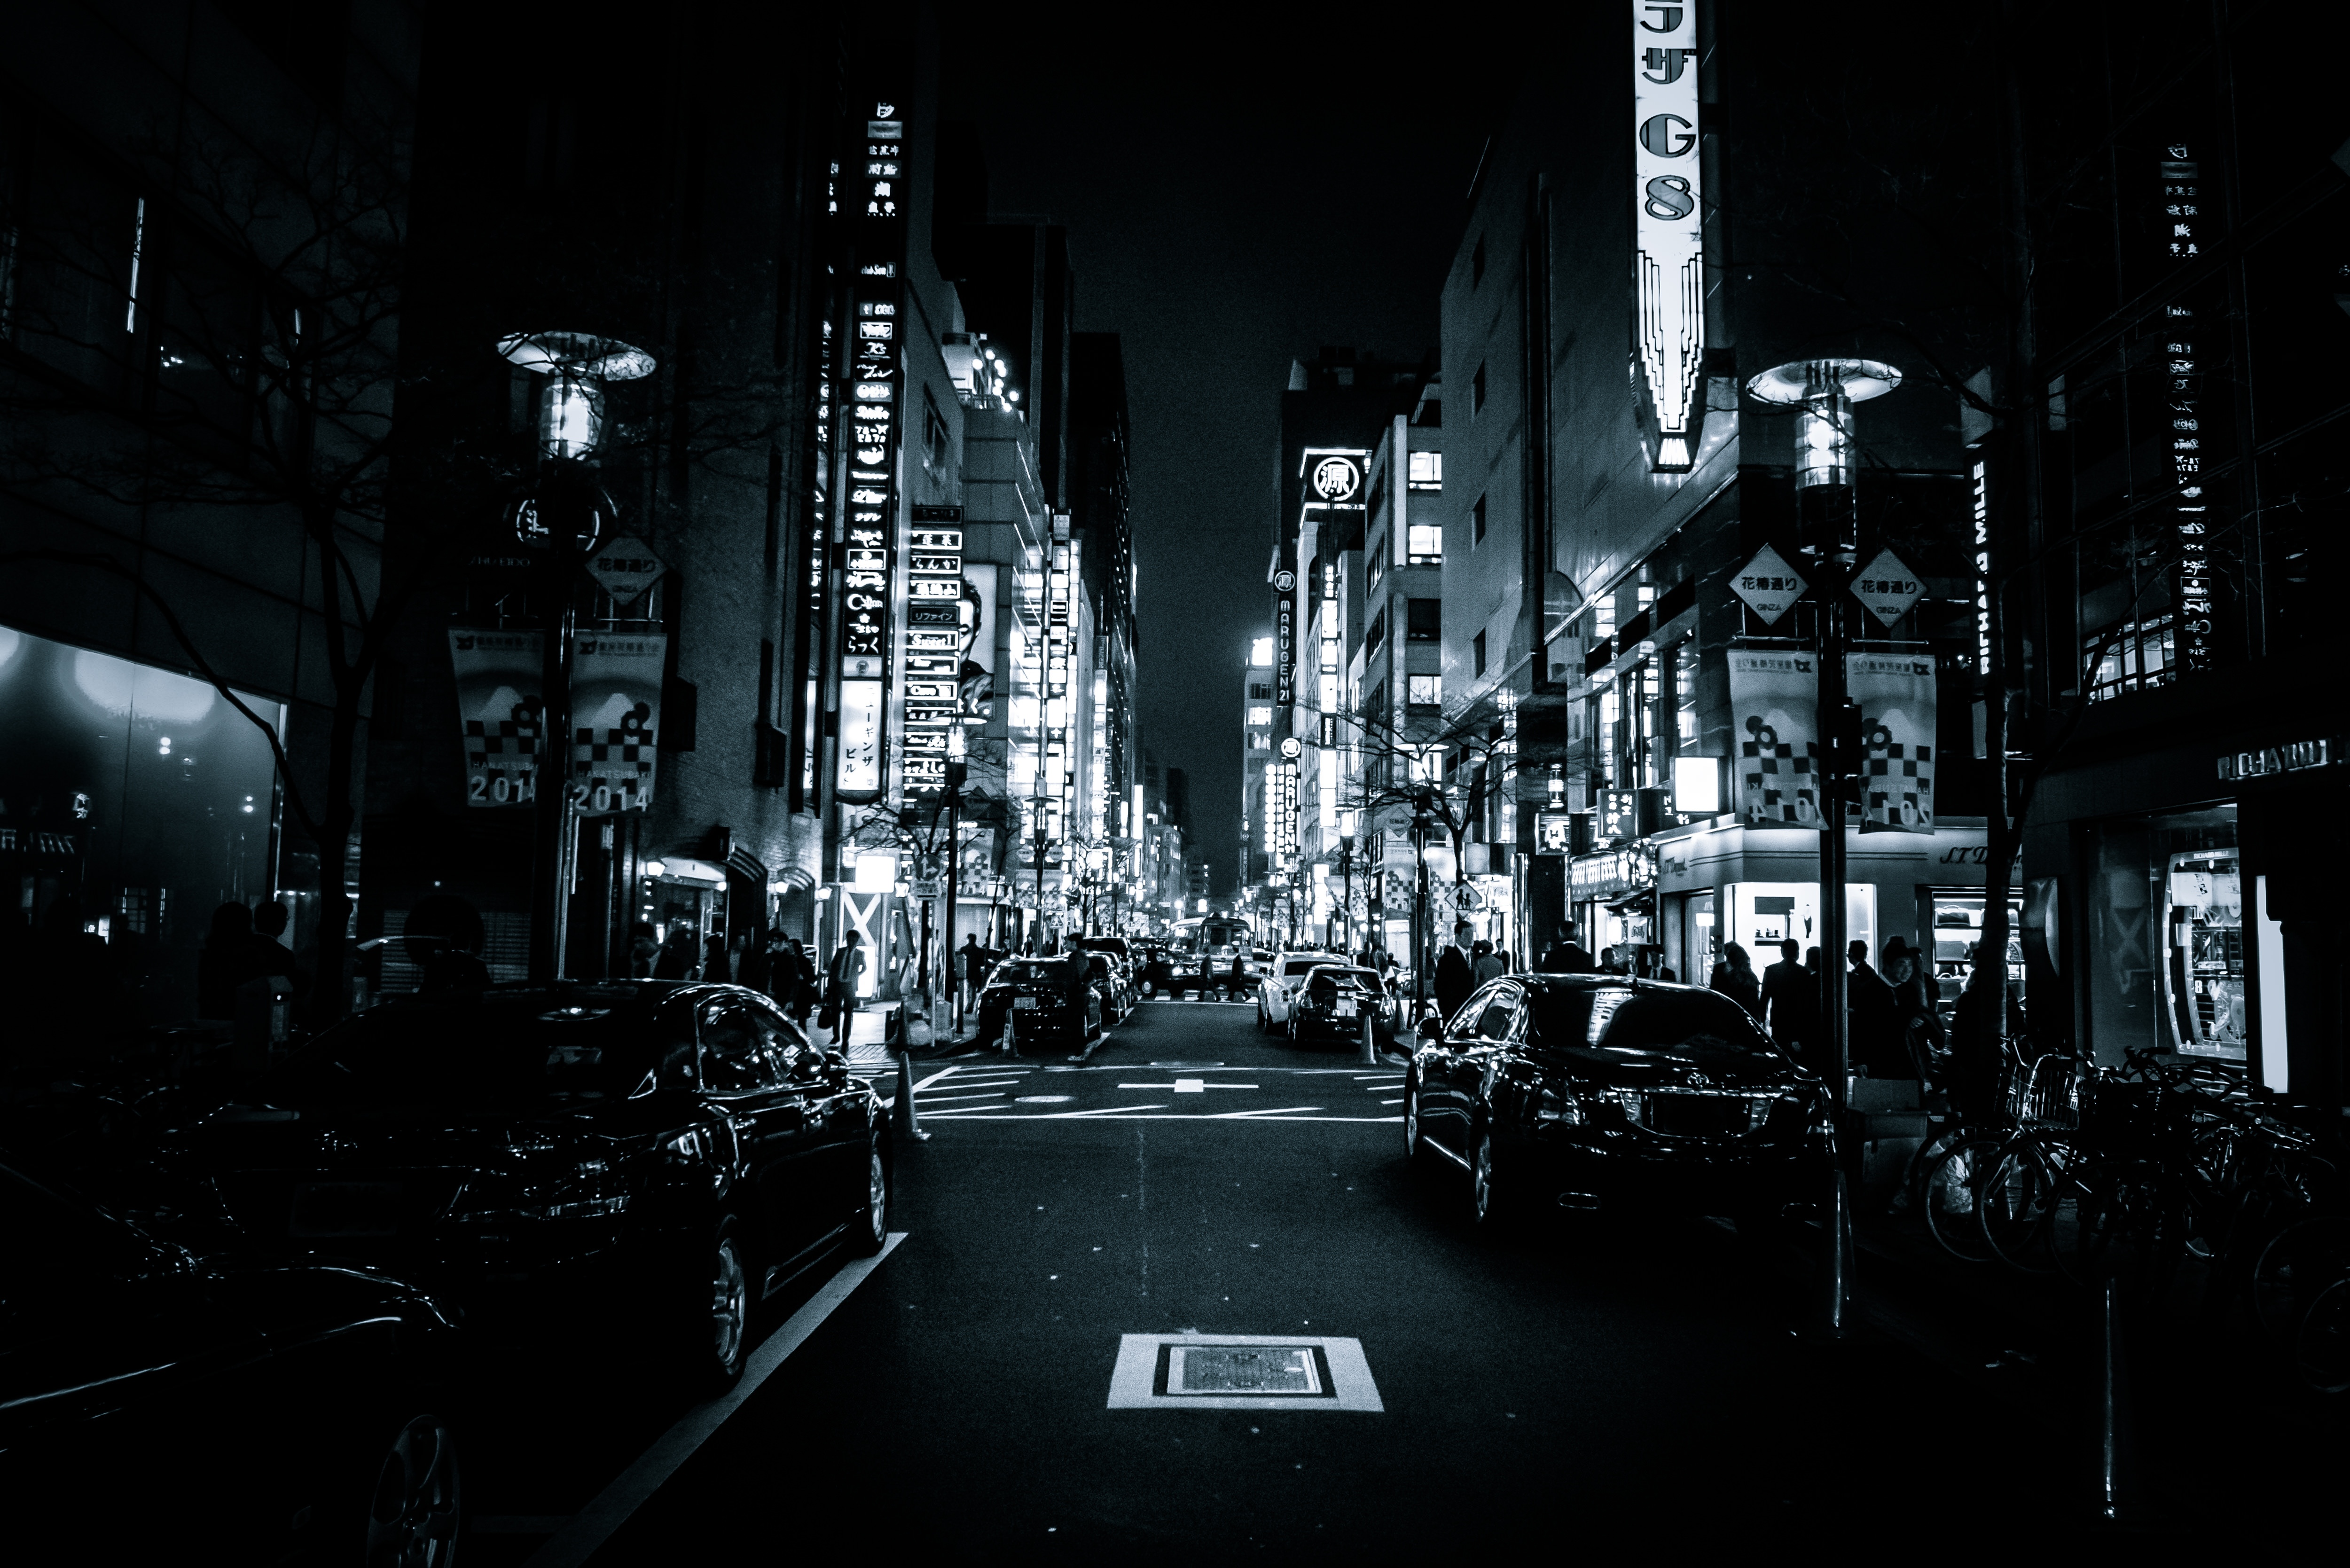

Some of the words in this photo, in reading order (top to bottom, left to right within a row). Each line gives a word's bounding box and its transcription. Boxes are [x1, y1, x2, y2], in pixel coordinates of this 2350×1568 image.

[1319, 464, 1349, 494] 源
[1742, 577, 1797, 591] 花椿通り
[1861, 580, 1917, 594] 花椿通り
[1756, 603, 1782, 612] GINZA
[848, 635, 878, 654] らっく
[1279, 600, 1290, 688] MARUGEN
[1279, 690, 1289, 701] 21
[573, 784, 648, 812] 2014
[1285, 763, 1297, 845] MARUGEN
